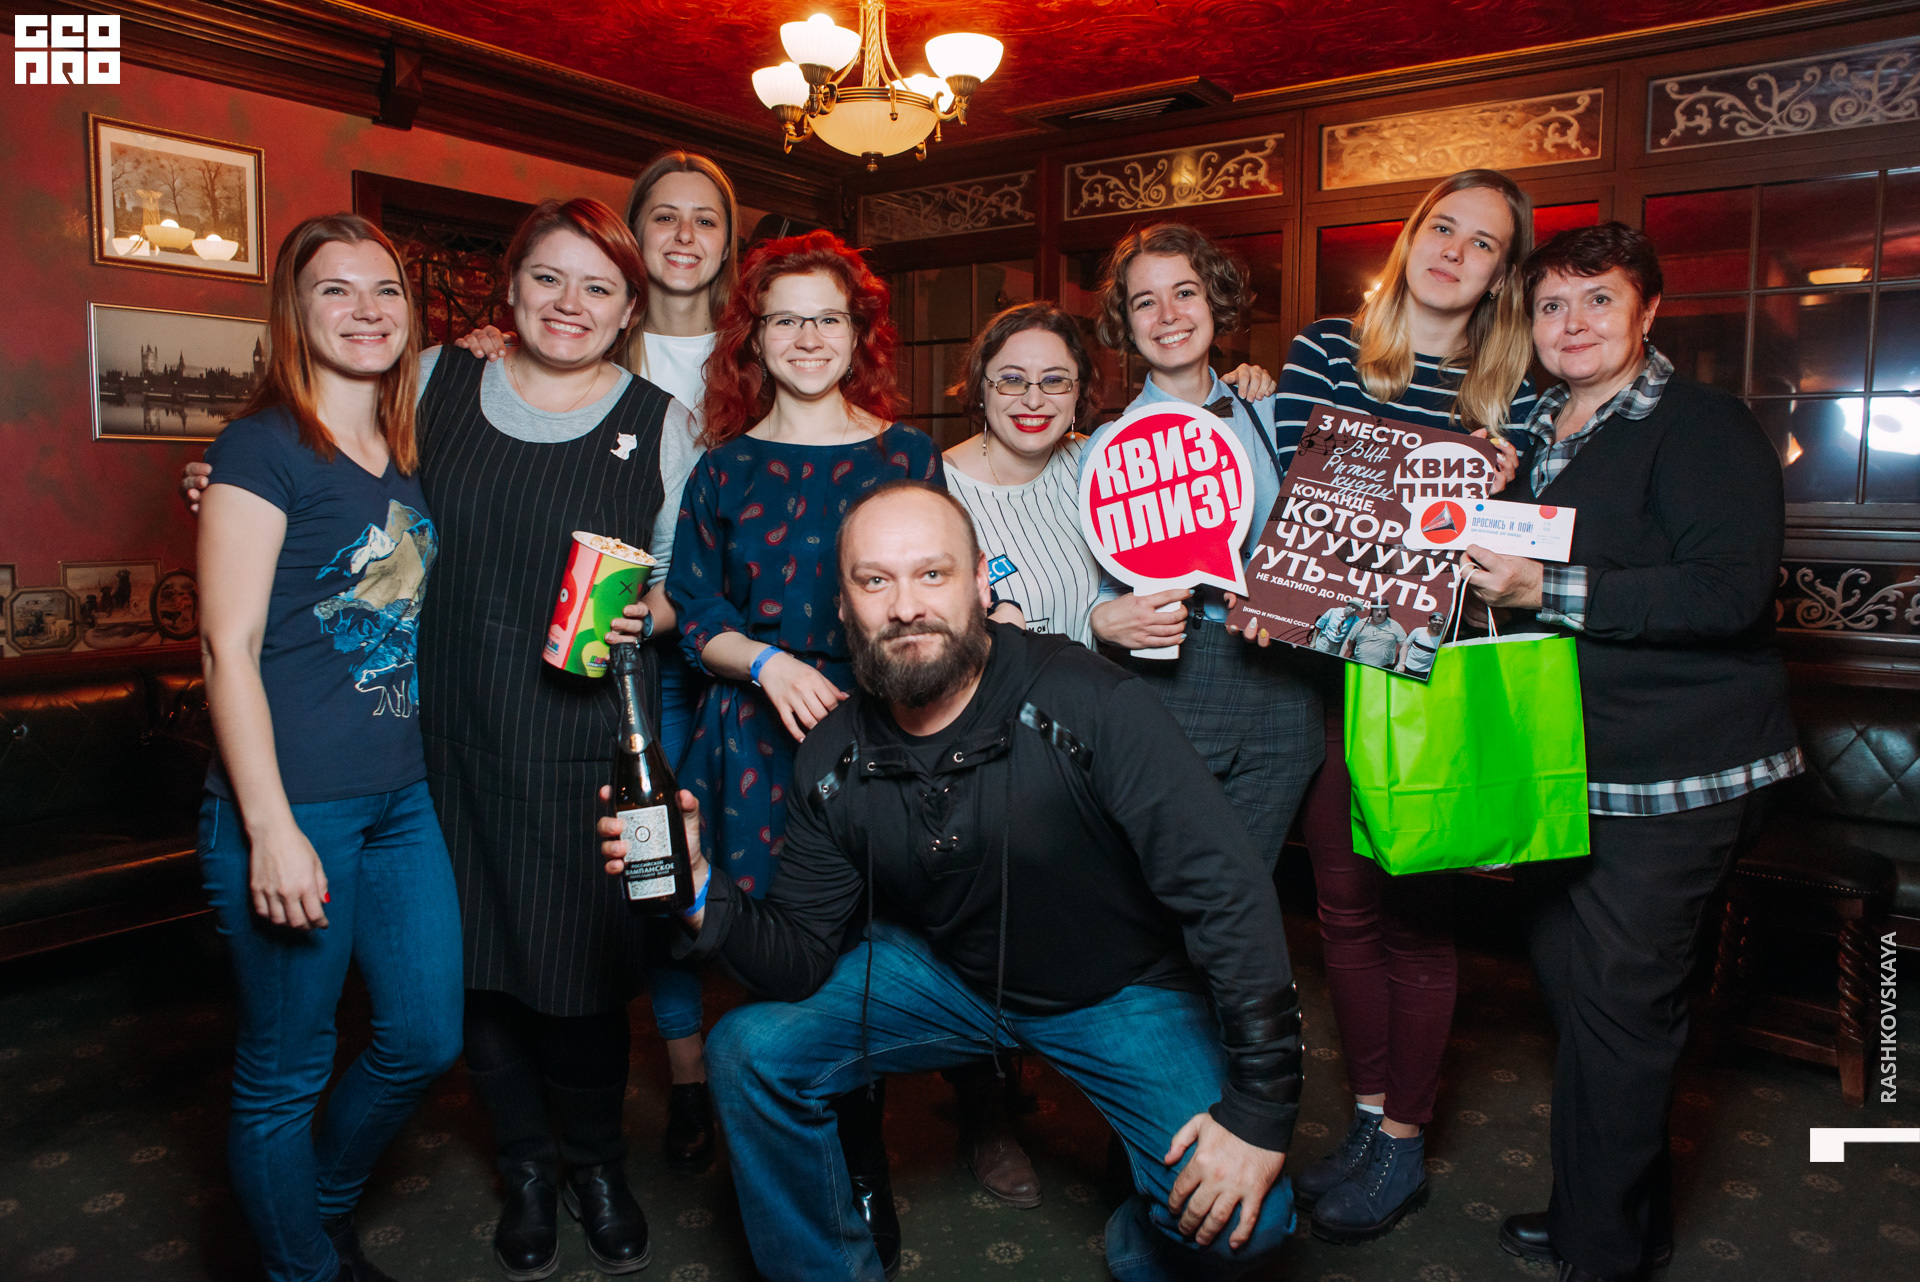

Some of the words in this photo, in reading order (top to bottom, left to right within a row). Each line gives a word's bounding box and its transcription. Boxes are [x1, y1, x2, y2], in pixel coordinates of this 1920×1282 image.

[1318, 415, 1333, 431] 3
[1338, 417, 1422, 450] МЕСТО
[1095, 419, 1229, 500] КВИЗ,
[1399, 457, 1495, 482] КВИЗ,
[1096, 468, 1241, 554] ПЛИЗ!
[1291, 483, 1376, 515] КОМАНДЕ,
[1471, 517, 1506, 529] ПРОСНИСЬ
[1509, 521, 1515, 531] И
[1517, 522, 1534, 533] ПОЙ!
[1256, 572, 1271, 584] НЕ
[1270, 575, 1318, 595] ХВАТИЛО
[1317, 587, 1335, 600] ДО
[1293, 619, 1310, 628] СССР
